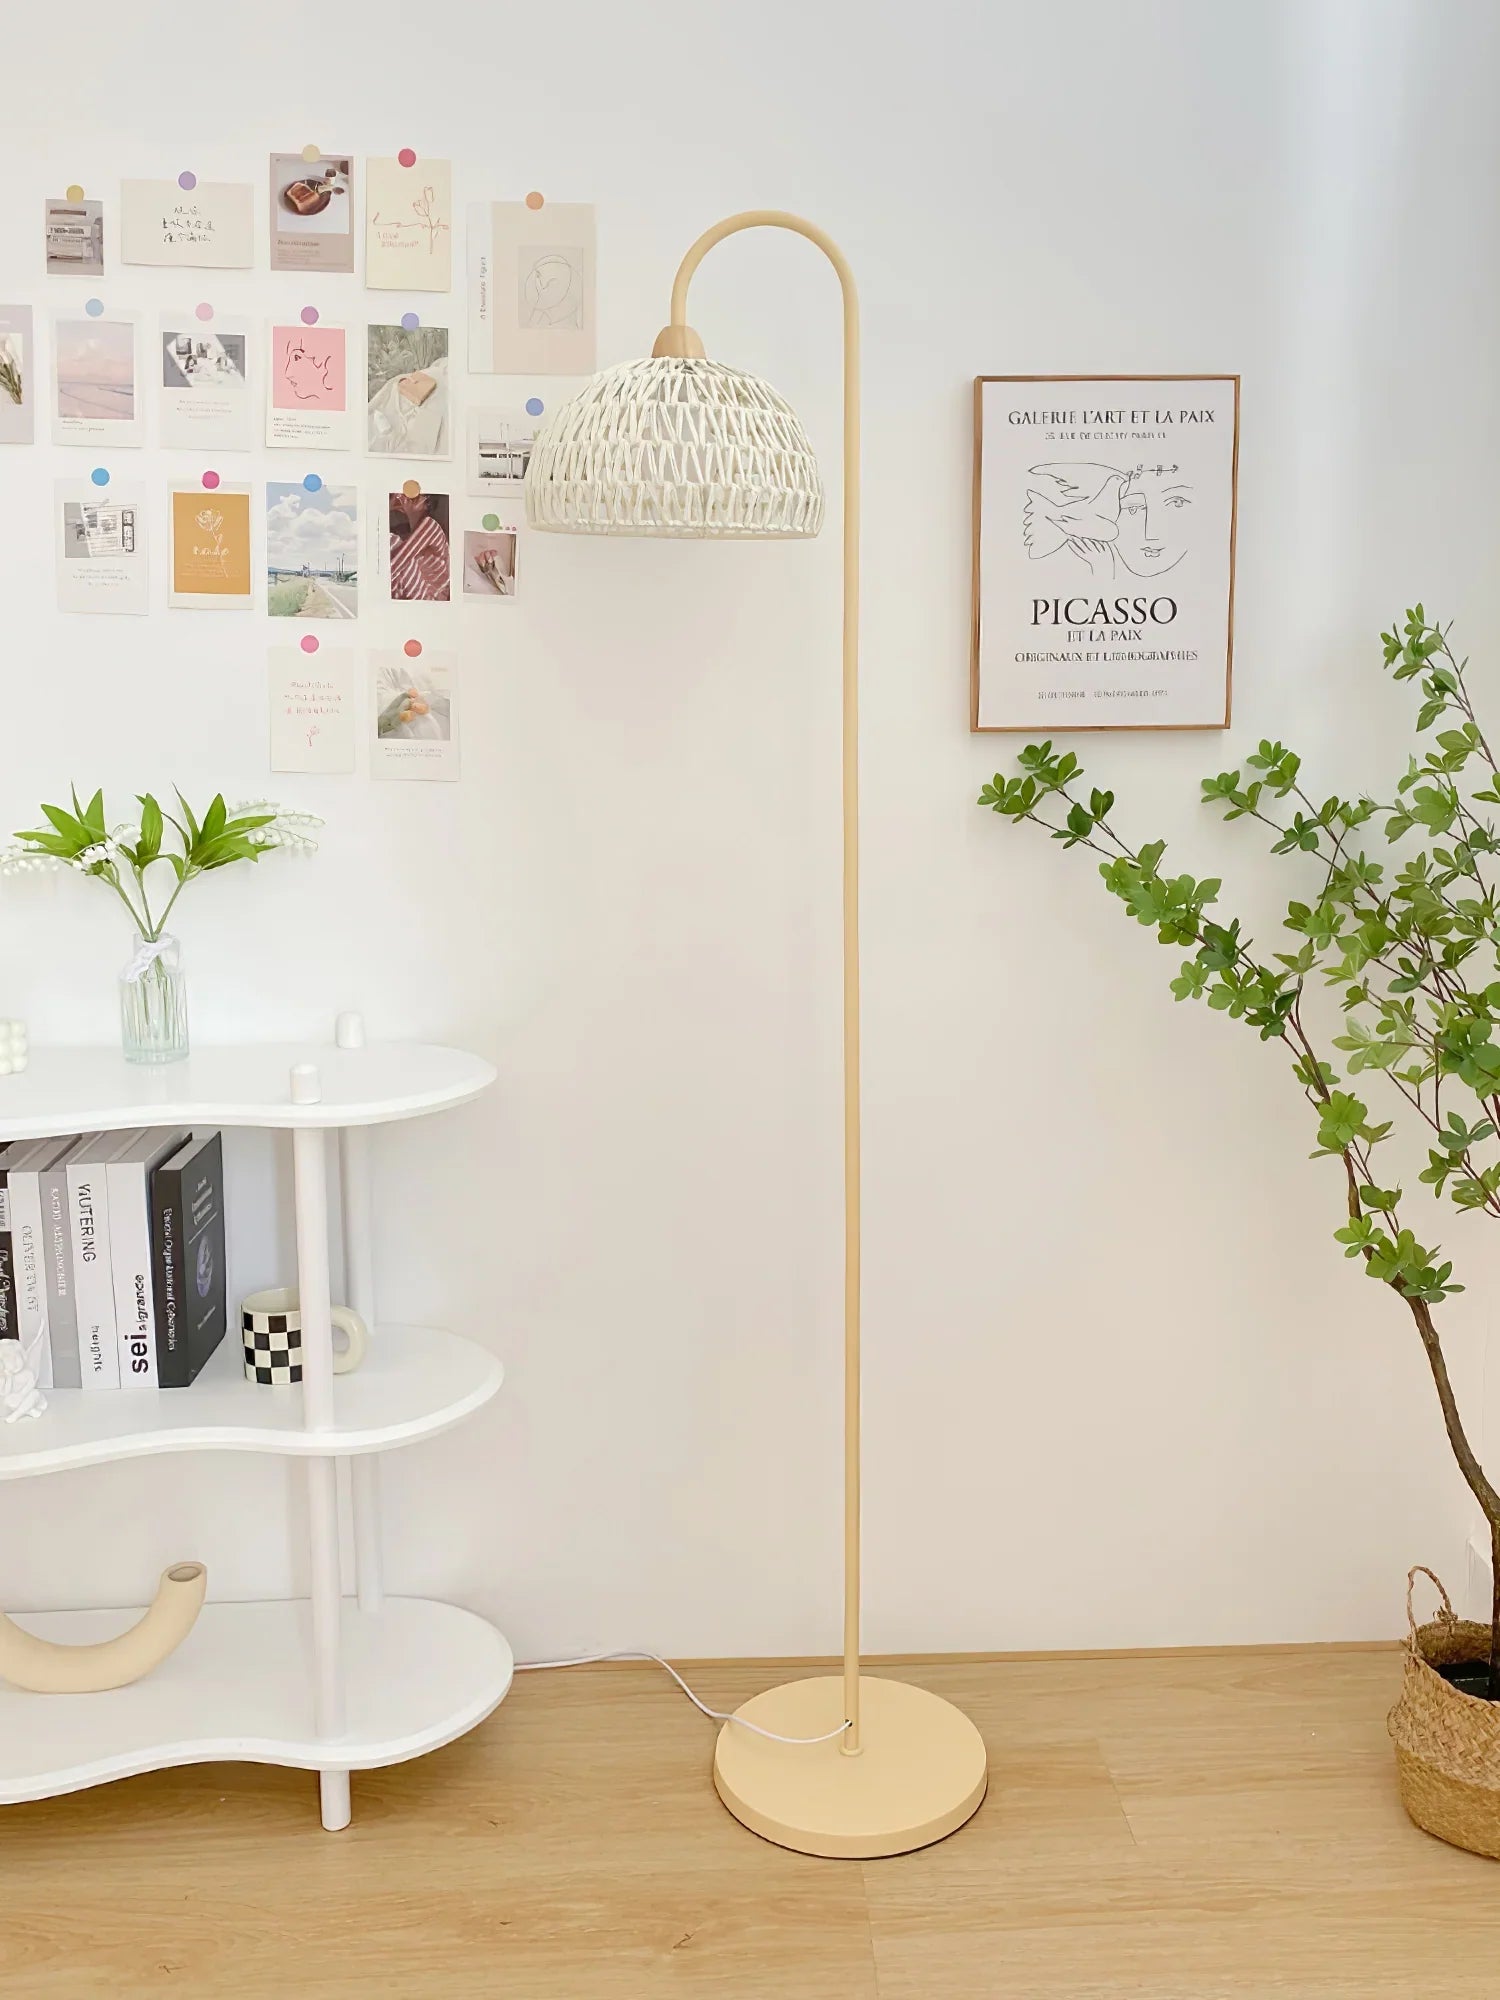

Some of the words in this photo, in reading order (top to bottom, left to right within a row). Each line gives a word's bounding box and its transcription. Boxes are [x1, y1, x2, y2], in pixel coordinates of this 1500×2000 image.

[1008, 410, 1077, 425] GALERIE
[1083, 410, 1125, 424] L'ART
[1131, 410, 1150, 424] ET
[1155, 410, 1174, 424] LA
[1180, 410, 1215, 424] PAIX
[1031, 597, 1178, 625] PICASSO
[1067, 630, 1085, 643] ET
[1089, 630, 1106, 642] LA
[1111, 629, 1142, 641] PAIX
[124, 1333, 149, 1374] sei
